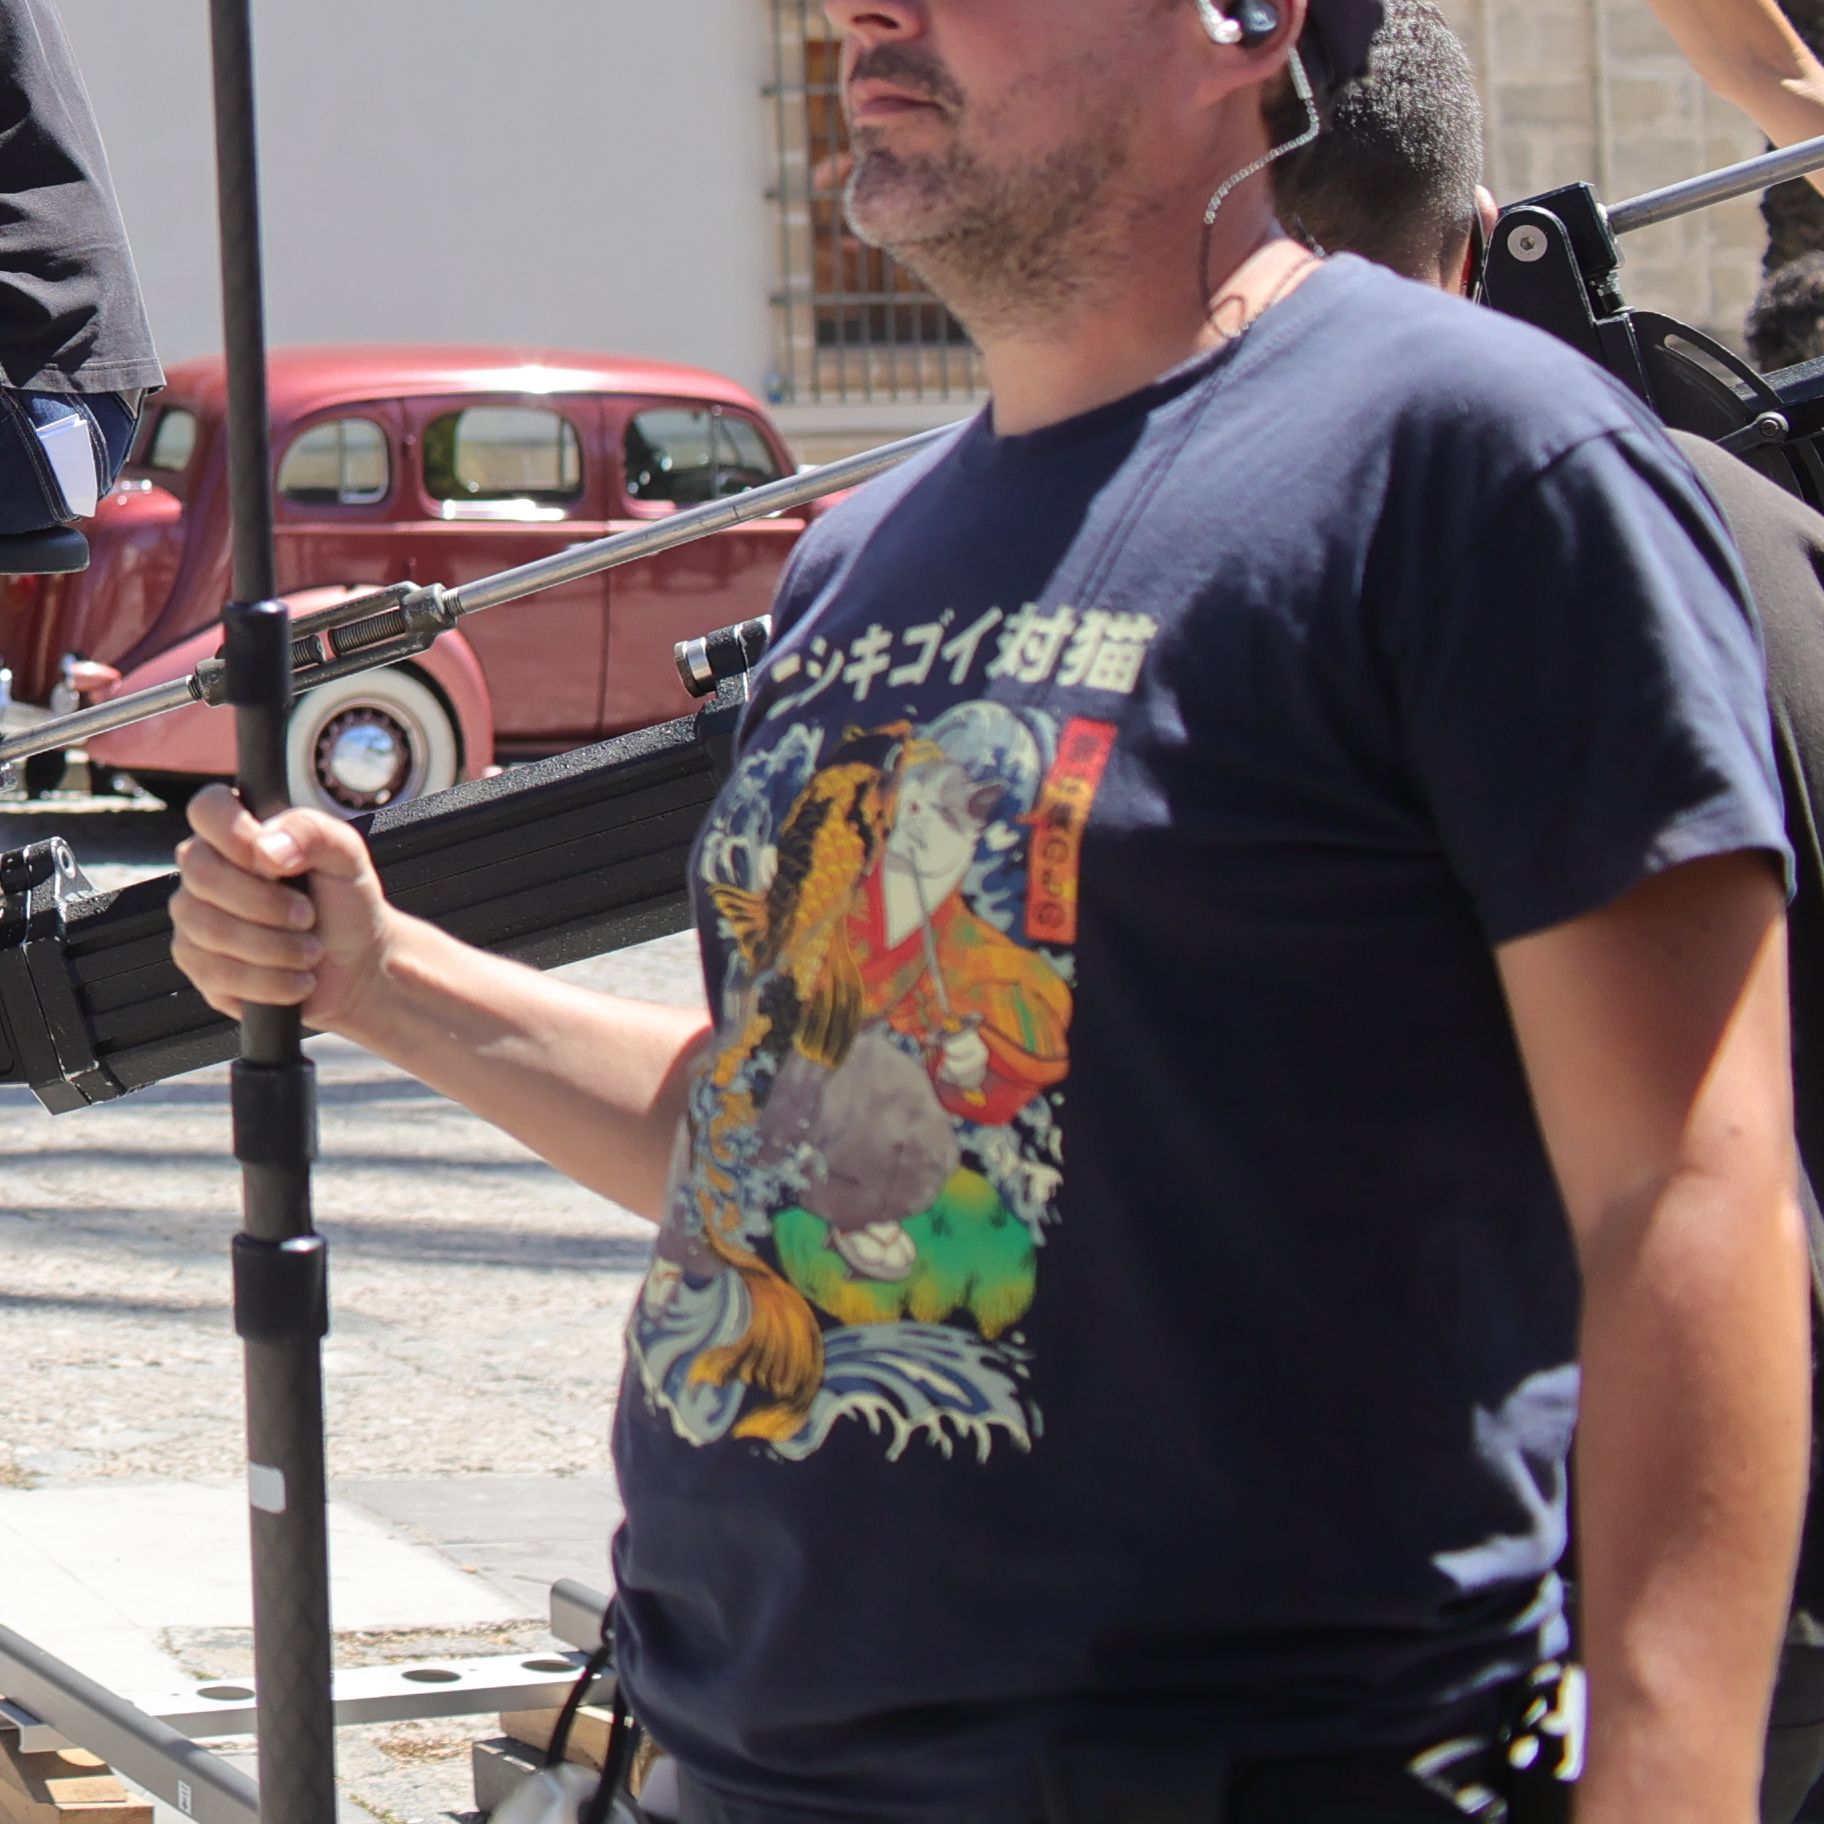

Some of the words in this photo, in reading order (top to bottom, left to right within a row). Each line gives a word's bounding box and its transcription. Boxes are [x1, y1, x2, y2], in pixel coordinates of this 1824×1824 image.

[766, 600, 1160, 721] ニシキゴイ対猫
